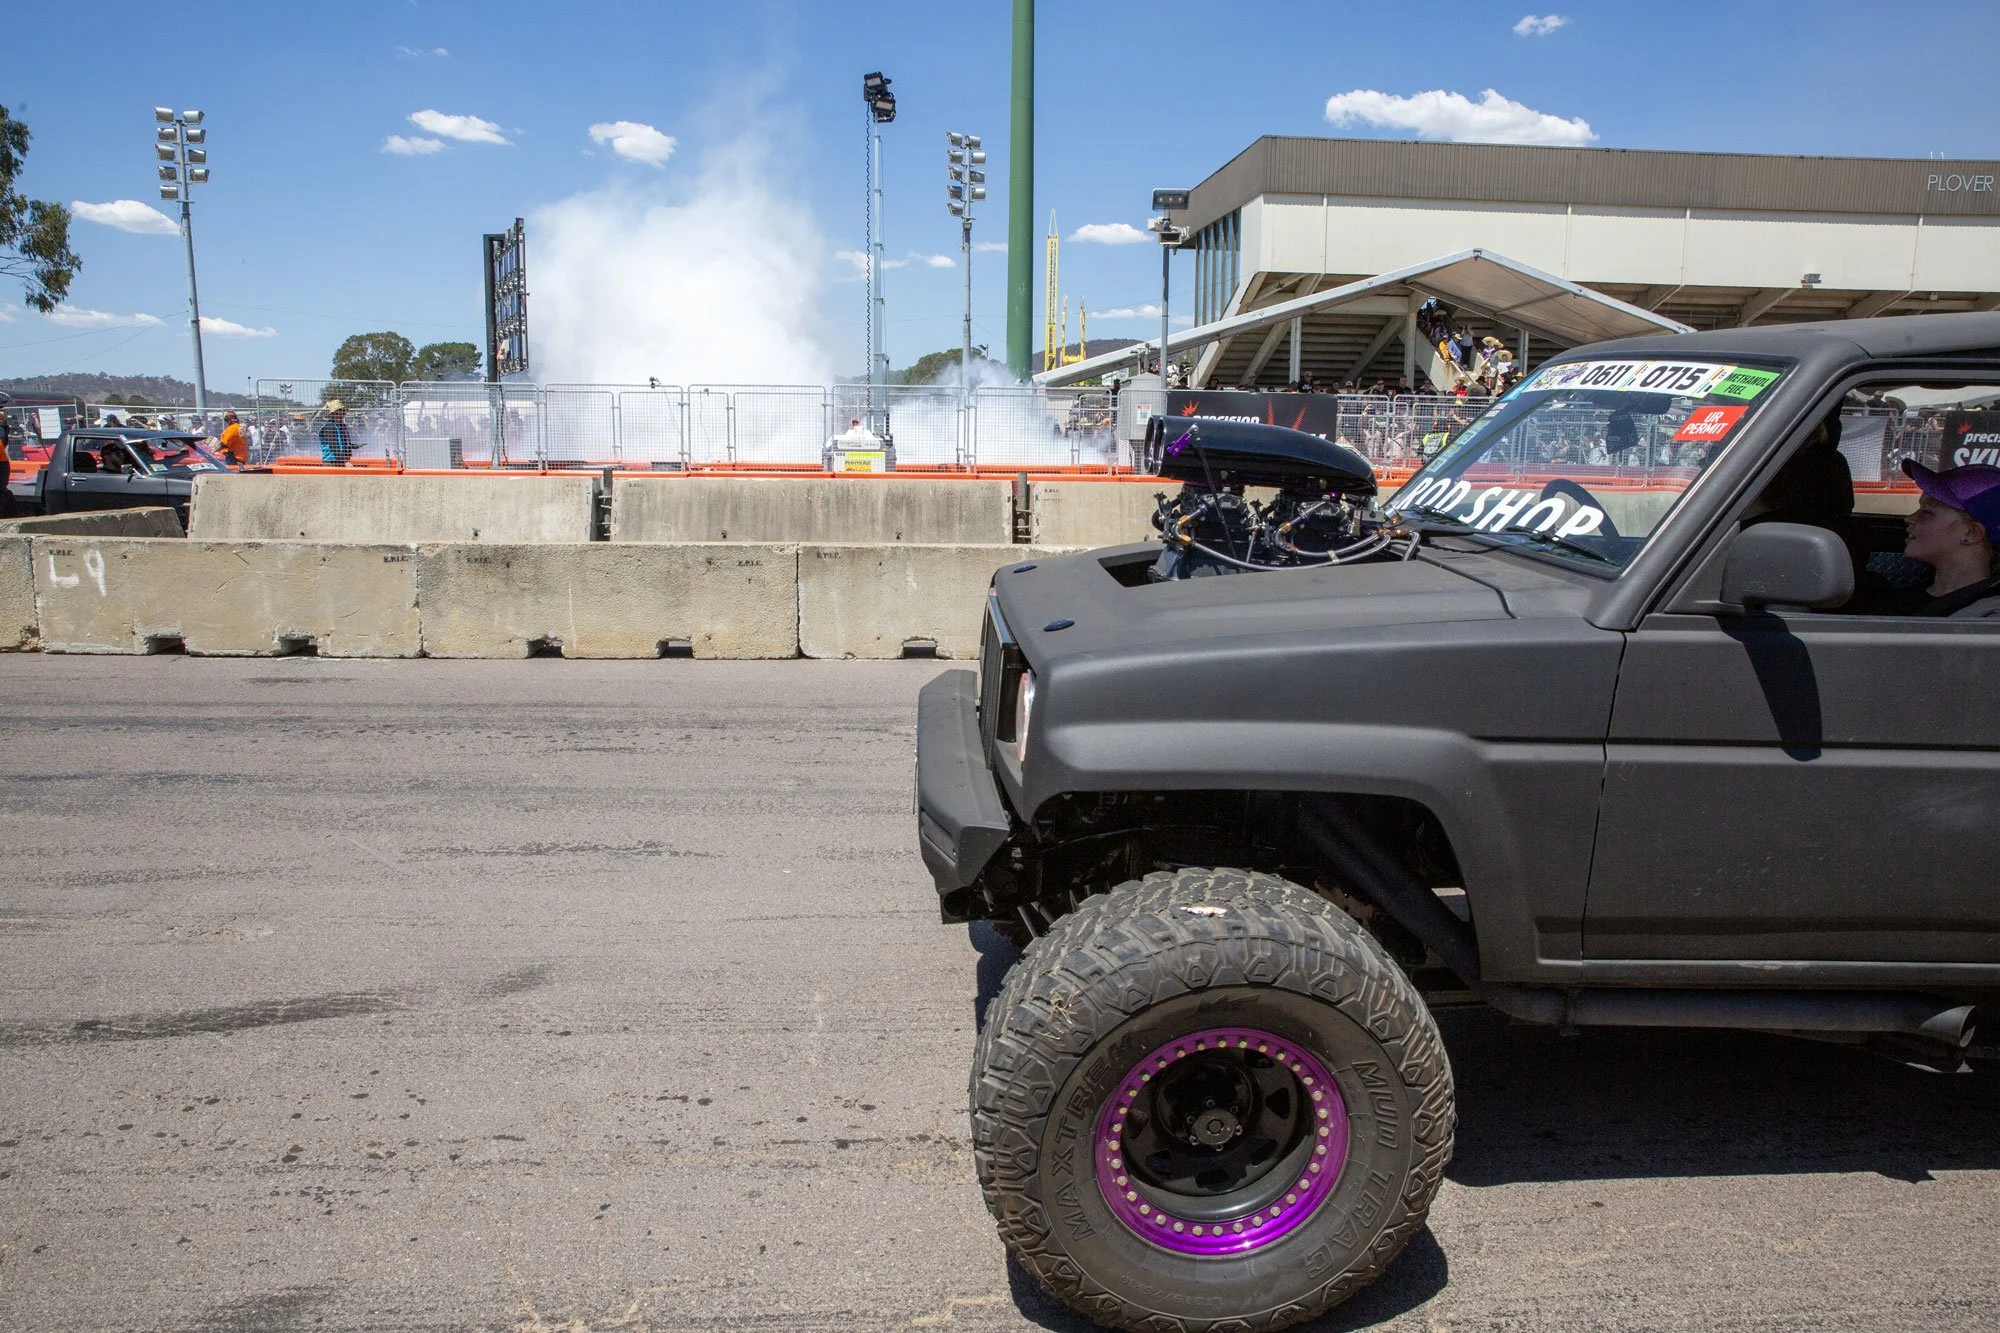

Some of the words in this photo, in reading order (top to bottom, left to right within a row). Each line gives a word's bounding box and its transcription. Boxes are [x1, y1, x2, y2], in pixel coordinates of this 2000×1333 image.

[1927, 174, 1994, 192] PLOVER
[1580, 365, 1632, 386] 0611
[1639, 365, 1709, 390] 0715
[1724, 372, 1770, 387] METHANOL
[1723, 384, 1747, 395] FUEL
[1703, 411, 1724, 423] UR
[1682, 423, 1728, 435] PERMIT
[1963, 433, 2000, 445] preci
[1397, 477, 1472, 516] ROD
[1458, 487, 1604, 541] SHOP
[1351, 1060, 1399, 1150] MUD
[1304, 1169, 1395, 1279] TRAC
